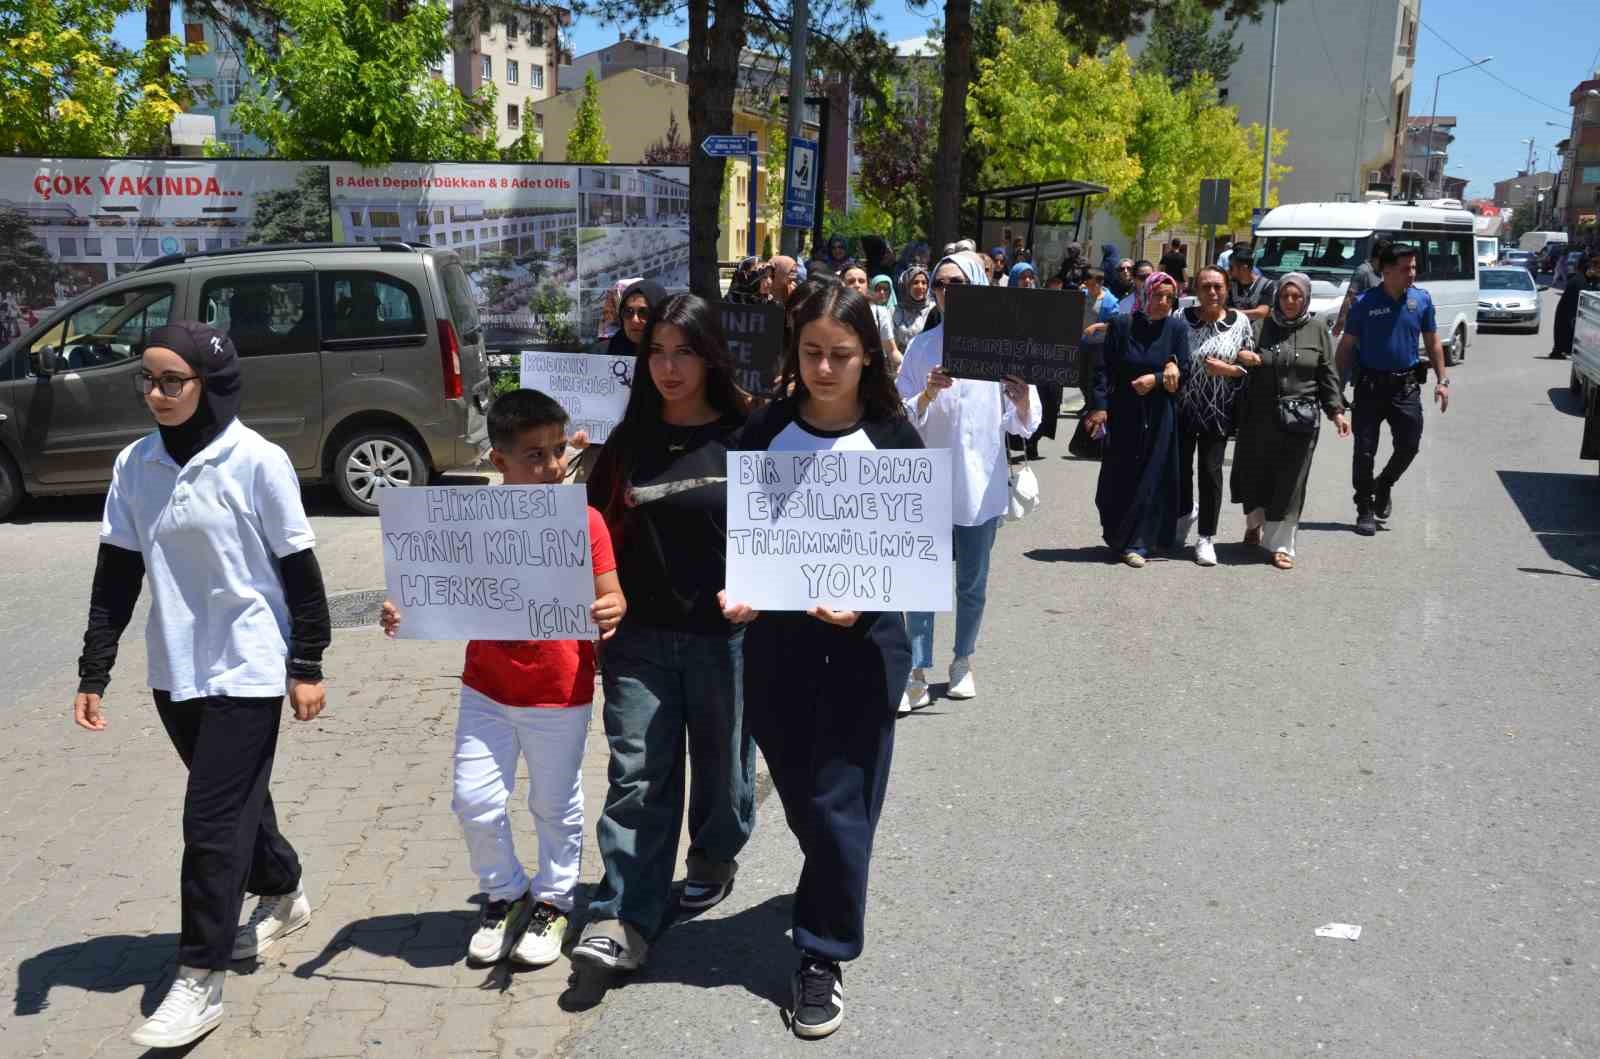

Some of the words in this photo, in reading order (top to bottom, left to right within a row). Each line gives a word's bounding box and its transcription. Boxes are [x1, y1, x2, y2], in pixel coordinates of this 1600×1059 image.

[34, 175, 92, 199] ÇOK
[99, 176, 243, 197] YAKINDA...
[335, 177, 344, 187] 8
[347, 176, 379, 188] Adet
[382, 176, 431, 190] Depolu
[434, 176, 485, 189] Dükkan
[488, 177, 497, 188] &
[500, 178, 508, 188] 8
[511, 178, 542, 189] Adet
[544, 178, 570, 189] Ofis
[739, 454, 780, 485] BİR
[792, 452, 847, 486] KİŞİ
[858, 456, 932, 484] DAHA
[425, 488, 558, 523] HİKAYESİ
[747, 489, 923, 523] EKSİLMEYE
[386, 530, 473, 565] YARIM
[484, 528, 586, 567] KALAN
[400, 574, 524, 612] HERKES
[800, 563, 892, 603] YOK!
